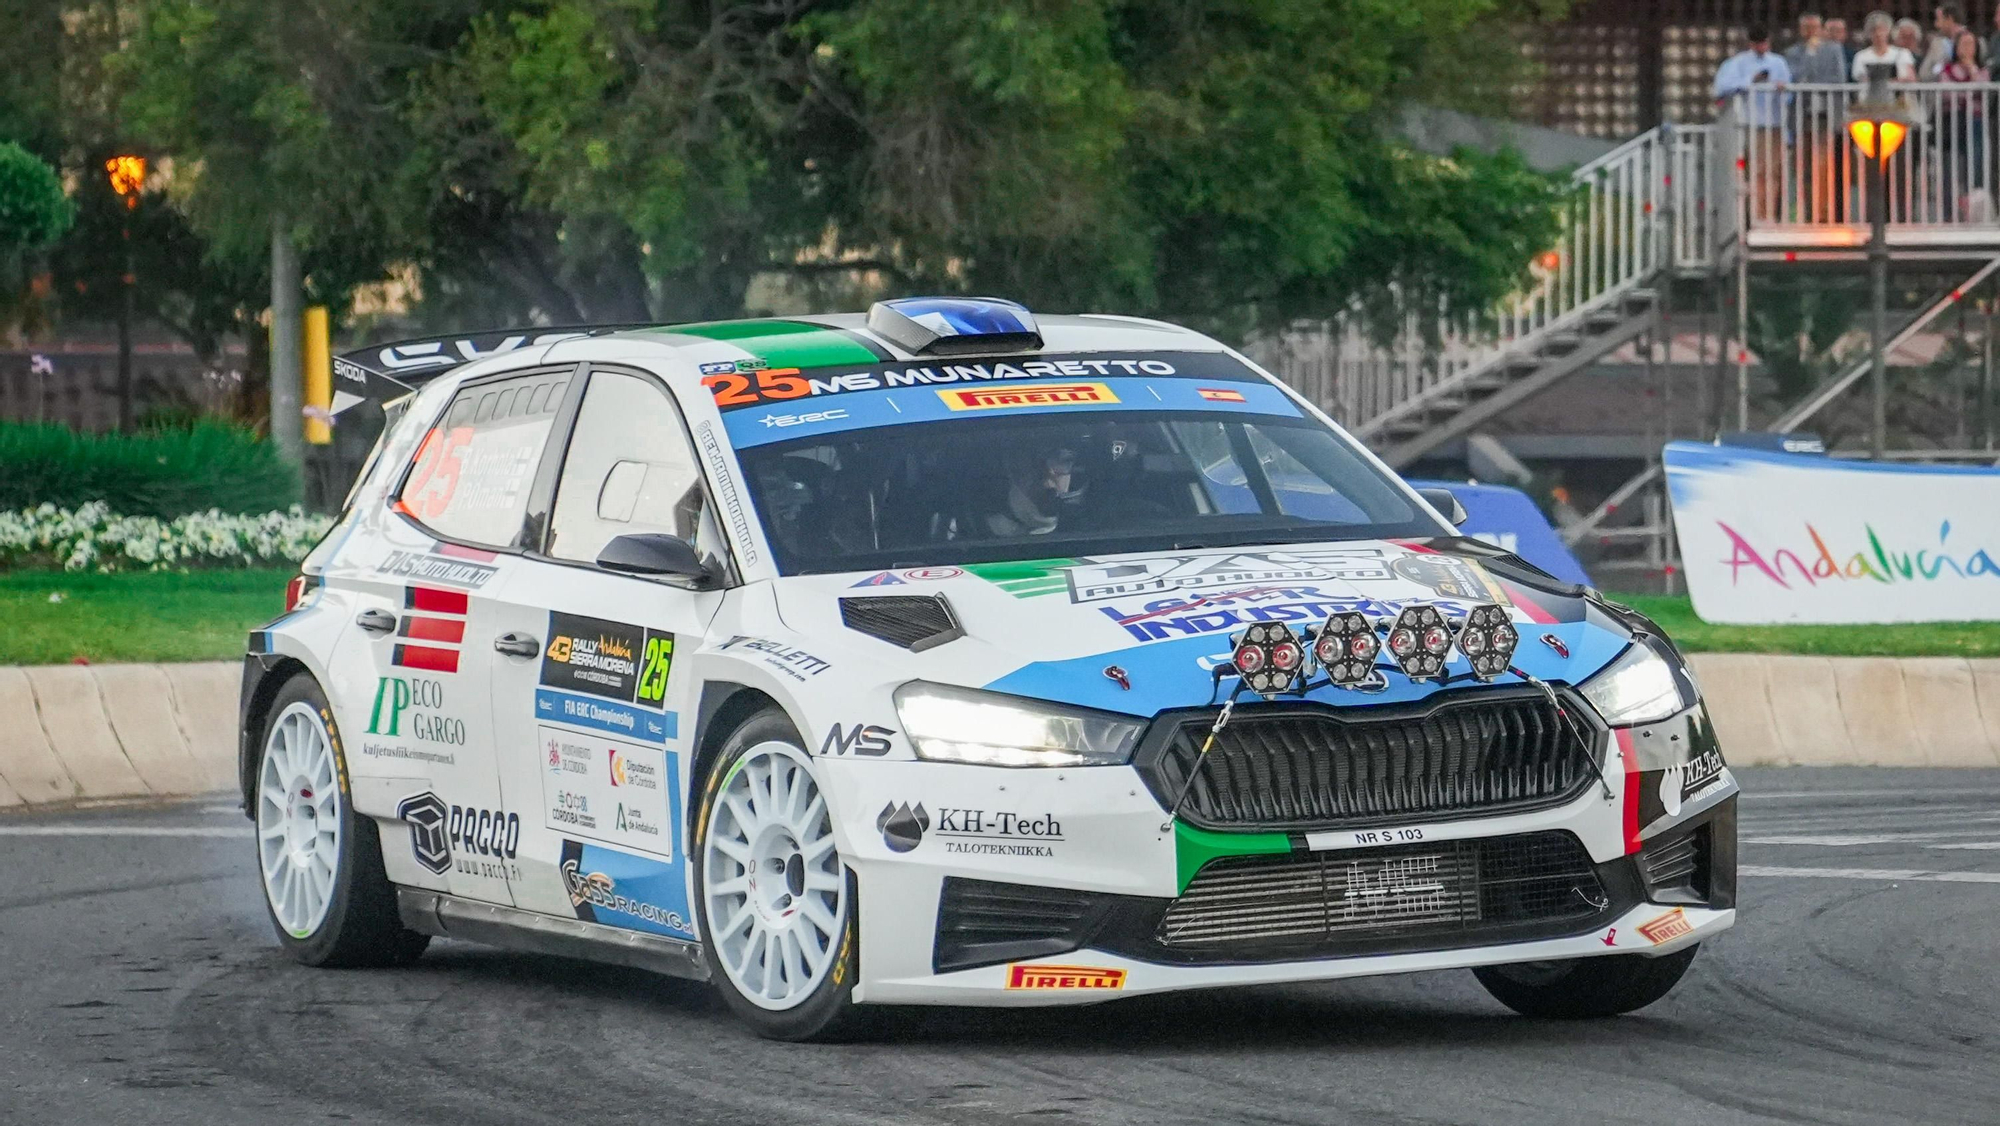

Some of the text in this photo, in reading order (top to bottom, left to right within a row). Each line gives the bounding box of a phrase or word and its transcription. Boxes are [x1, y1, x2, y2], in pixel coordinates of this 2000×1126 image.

[701, 368, 812, 406] 25
[806, 361, 1176, 396] MS MUNARETTO
[955, 386, 1101, 407] PIRELLI
[774, 409, 849, 427] ERC
[1716, 520, 2000, 589] Andalucía
[547, 635, 572, 663] 43
[572, 638, 600, 654] RALLY
[569, 652, 602, 668] SIERRA
[598, 656, 634, 676] MORENA
[638, 637, 672, 701] 25
[412, 678, 443, 709] ECO
[564, 700, 576, 716] FIA
[414, 713, 465, 746] GARGO
[820, 722, 897, 756] MS
[1684, 745, 1722, 785] KH-Tech
[938, 807, 1062, 836] KH-Tech
[1355, 828, 1424, 845] NR S 103
[946, 842, 1054, 857] TALOTEKNIIKKA
[615, 895, 683, 932] RACING
[1637, 908, 1692, 944] PIRELLI
[1010, 966, 1122, 988] PIRELLI
